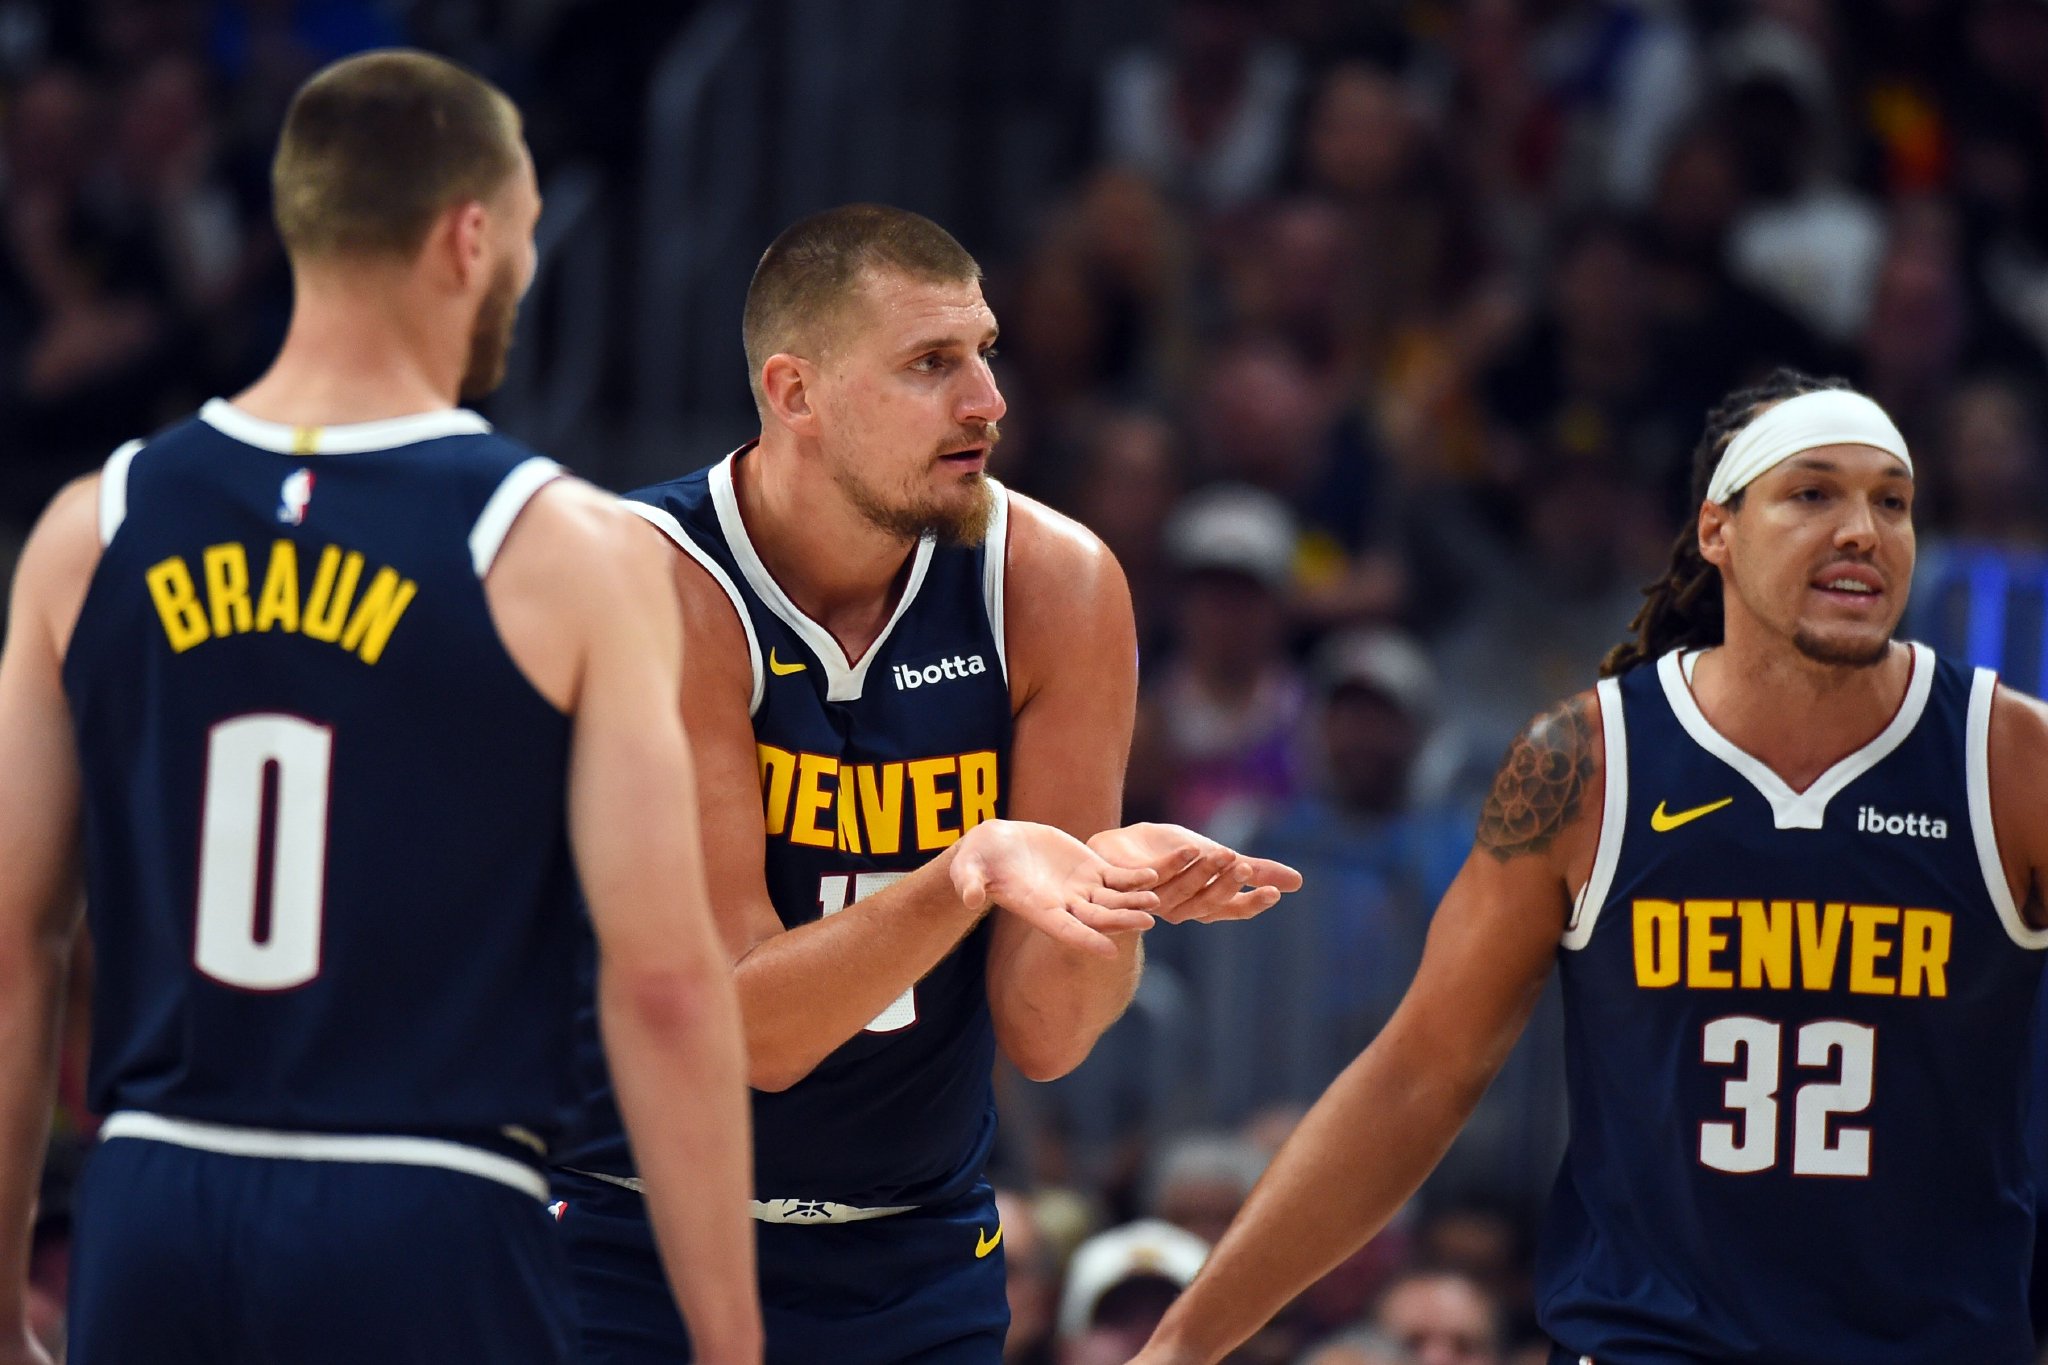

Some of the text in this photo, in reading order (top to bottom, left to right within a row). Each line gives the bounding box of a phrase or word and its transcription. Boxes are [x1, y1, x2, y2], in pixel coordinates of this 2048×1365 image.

[146, 540, 418, 664] BRAUN
[893, 652, 986, 690] ibotta
[194, 712, 333, 991] 0
[1857, 806, 1948, 839] ibotta
[1632, 898, 1953, 998] DENVER
[1699, 1015, 1876, 1178] 32
